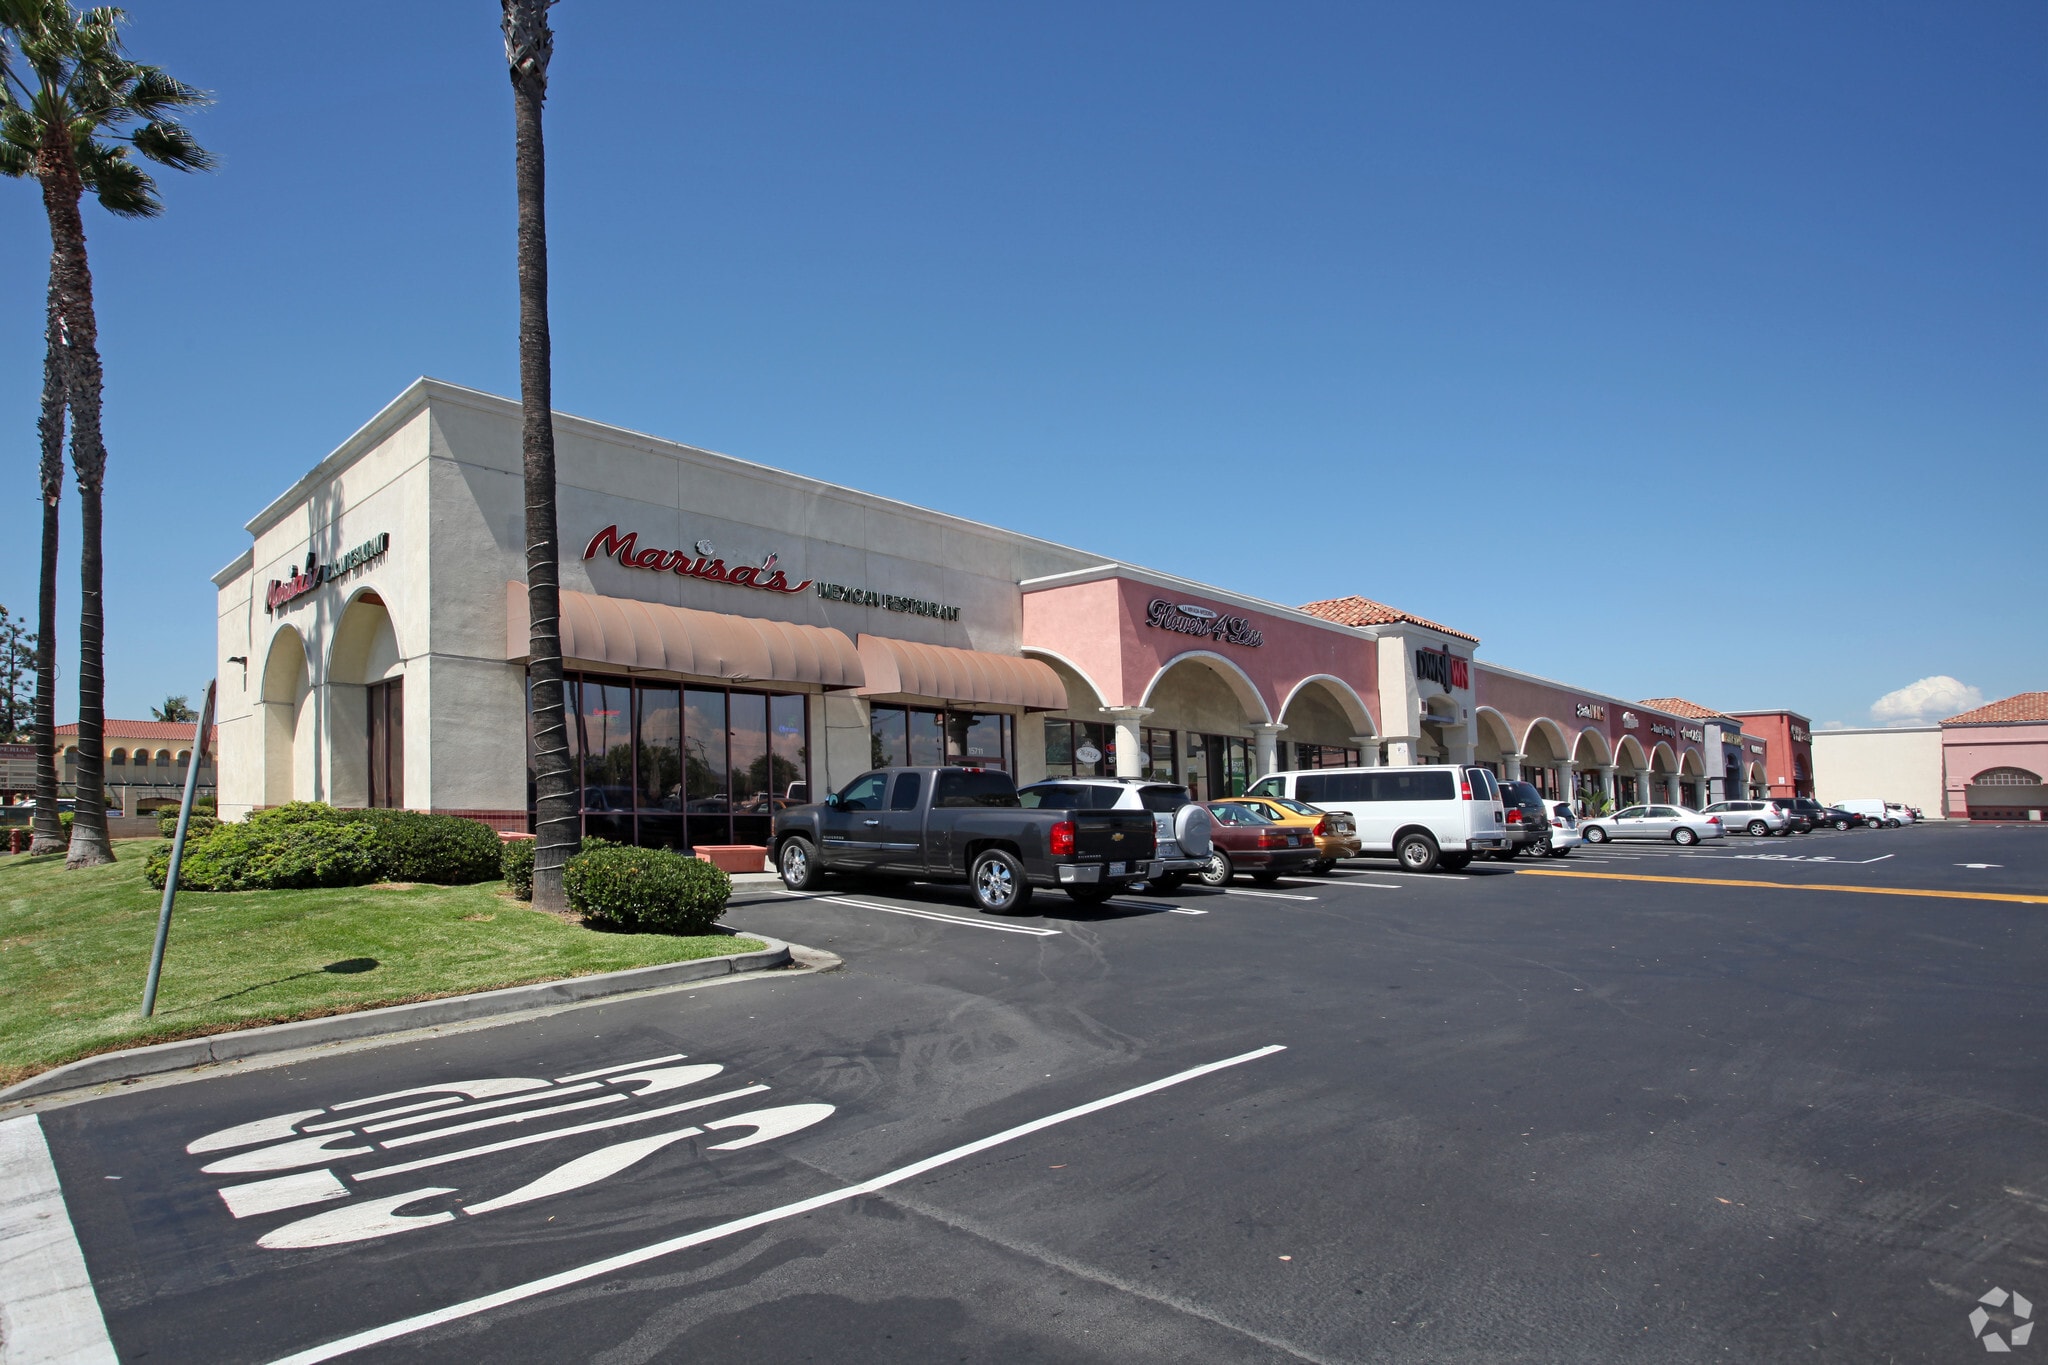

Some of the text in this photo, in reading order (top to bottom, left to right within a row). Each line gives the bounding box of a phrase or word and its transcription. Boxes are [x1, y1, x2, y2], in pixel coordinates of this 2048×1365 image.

[583, 524, 962, 621] Marisa's MEXICAN RESTAURANT
[1146, 599, 1265, 647] Flowers 4 Less
[968, 747, 984, 756] 15711
[186, 1053, 836, 1250] STOP
